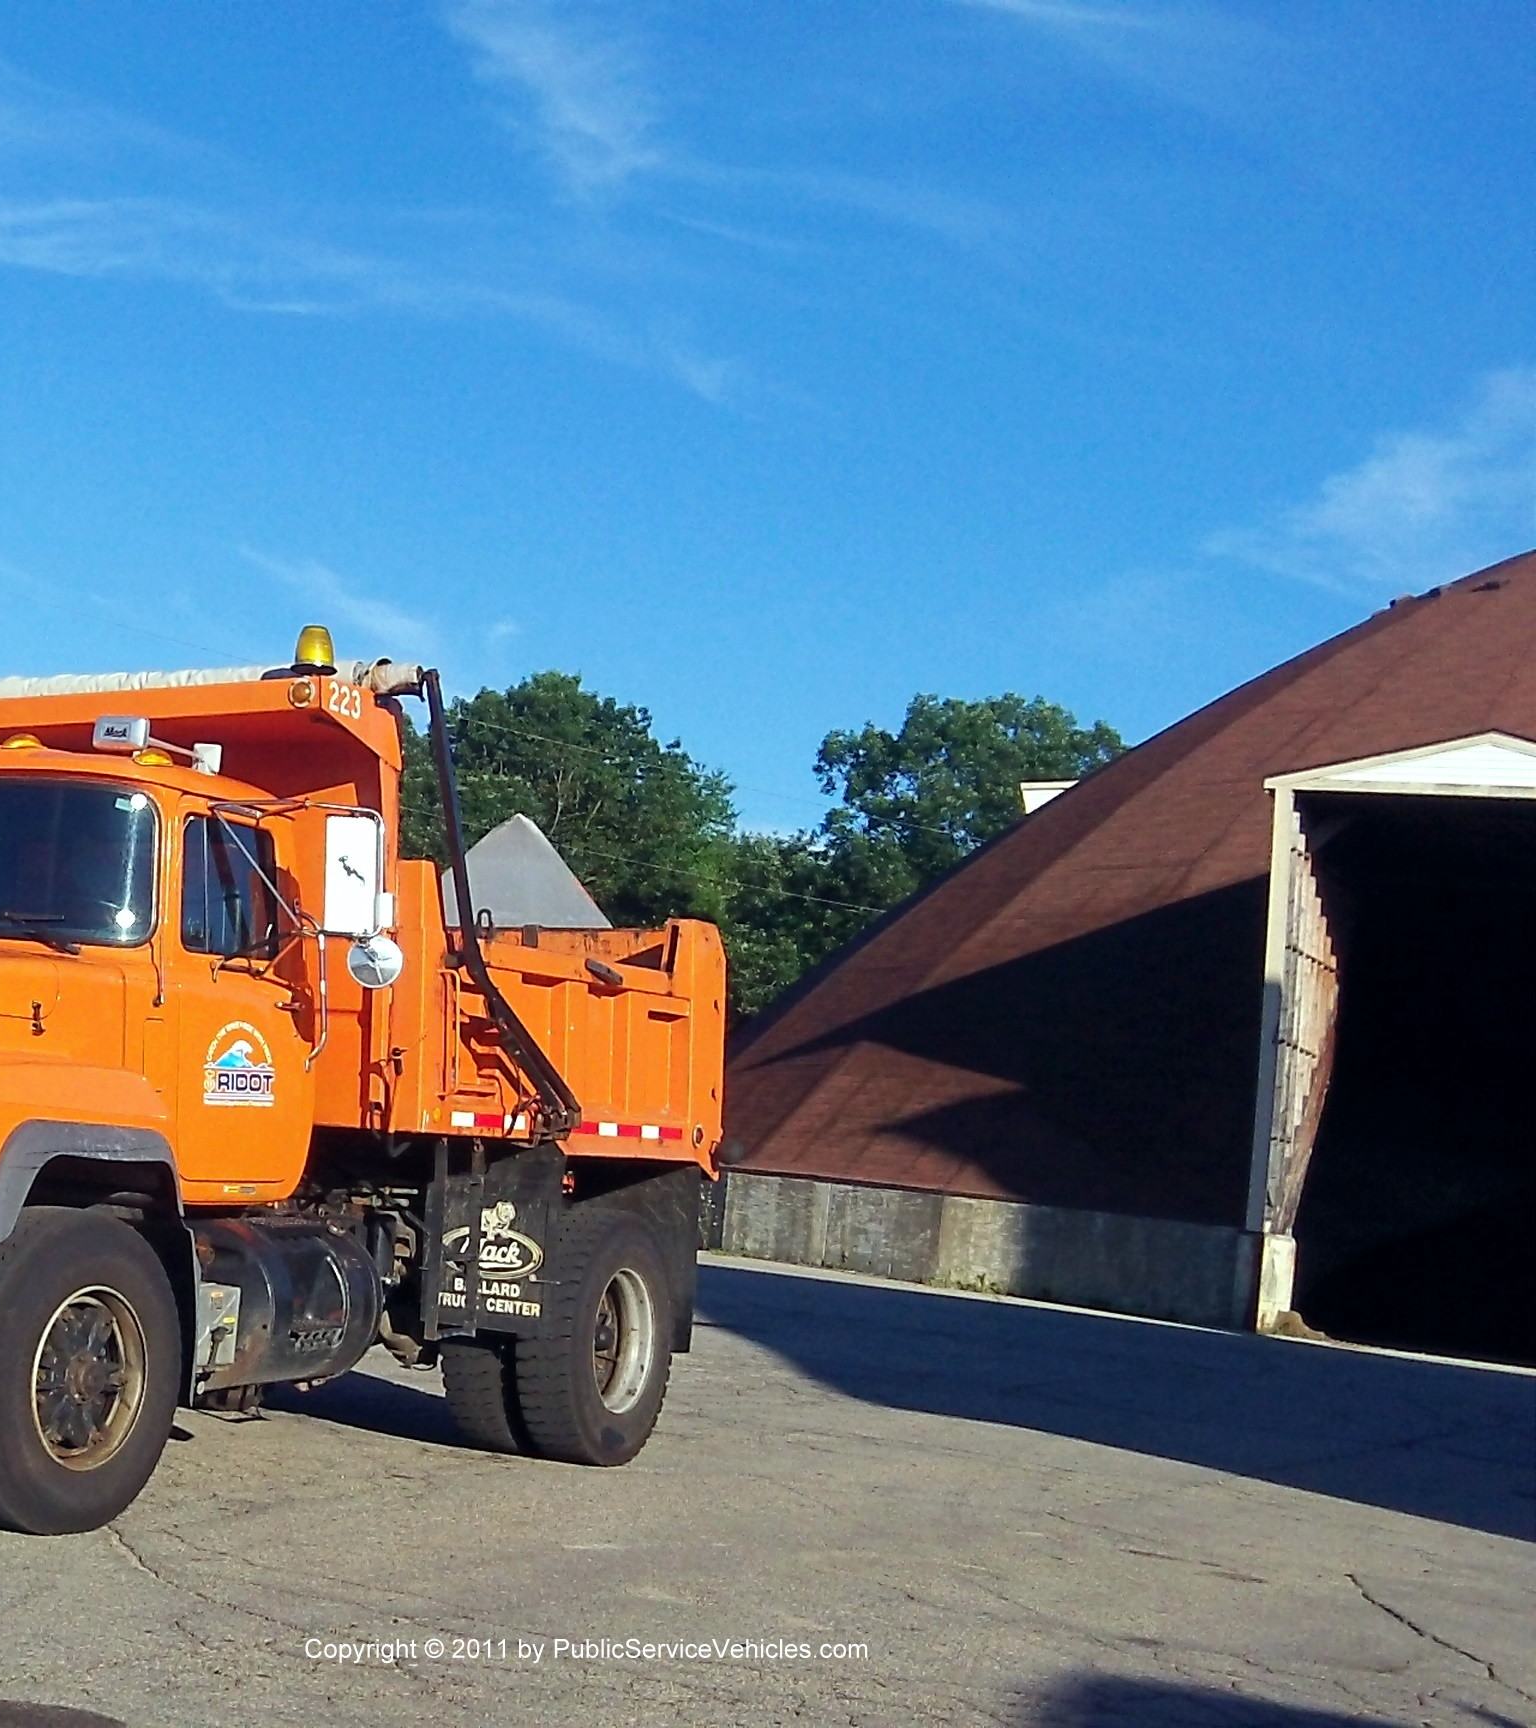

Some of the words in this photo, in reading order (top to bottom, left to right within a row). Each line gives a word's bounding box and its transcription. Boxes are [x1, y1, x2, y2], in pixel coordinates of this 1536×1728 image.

[328, 680, 362, 720] 223
[217, 1072, 275, 1093] RIDOT
[453, 1277, 521, 1298] BLARD
[485, 1297, 542, 1318] CENTER
